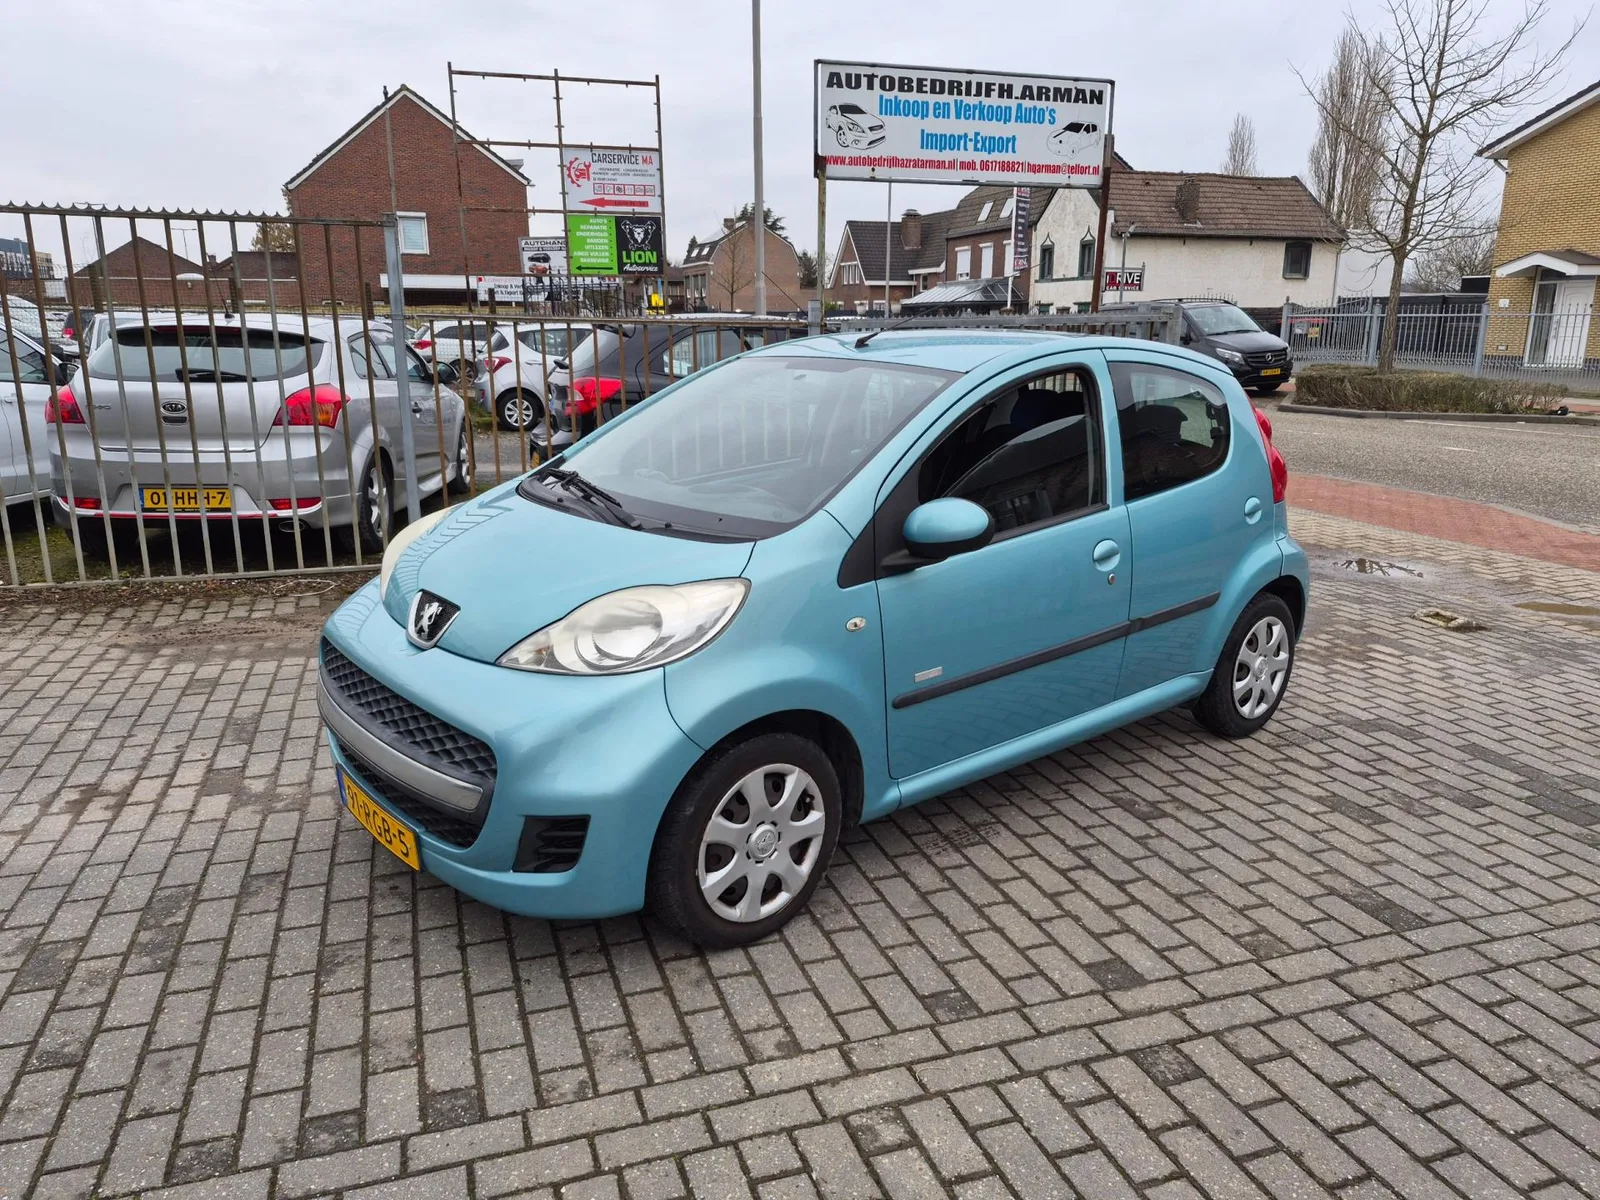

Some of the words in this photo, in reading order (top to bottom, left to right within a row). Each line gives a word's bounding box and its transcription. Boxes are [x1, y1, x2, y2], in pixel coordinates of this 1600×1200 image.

[826, 72, 1104, 105] AUTOBEDRIJFH.ARMAN
[878, 94, 930, 120] Inkoop
[933, 101, 950, 119] en
[954, 99, 1012, 124] Verkoop
[1014, 103, 1056, 125] Auto's
[920, 129, 1017, 154] Import-Export
[591, 152, 640, 165] CARSERVICE
[641, 155, 653, 165] MA
[959, 159, 978, 171] mob.
[622, 250, 657, 264] LION
[623, 264, 659, 272] Autoservice
[164, 403, 184, 412] KIA
[347, 784, 410, 858] 91-RGB-5
